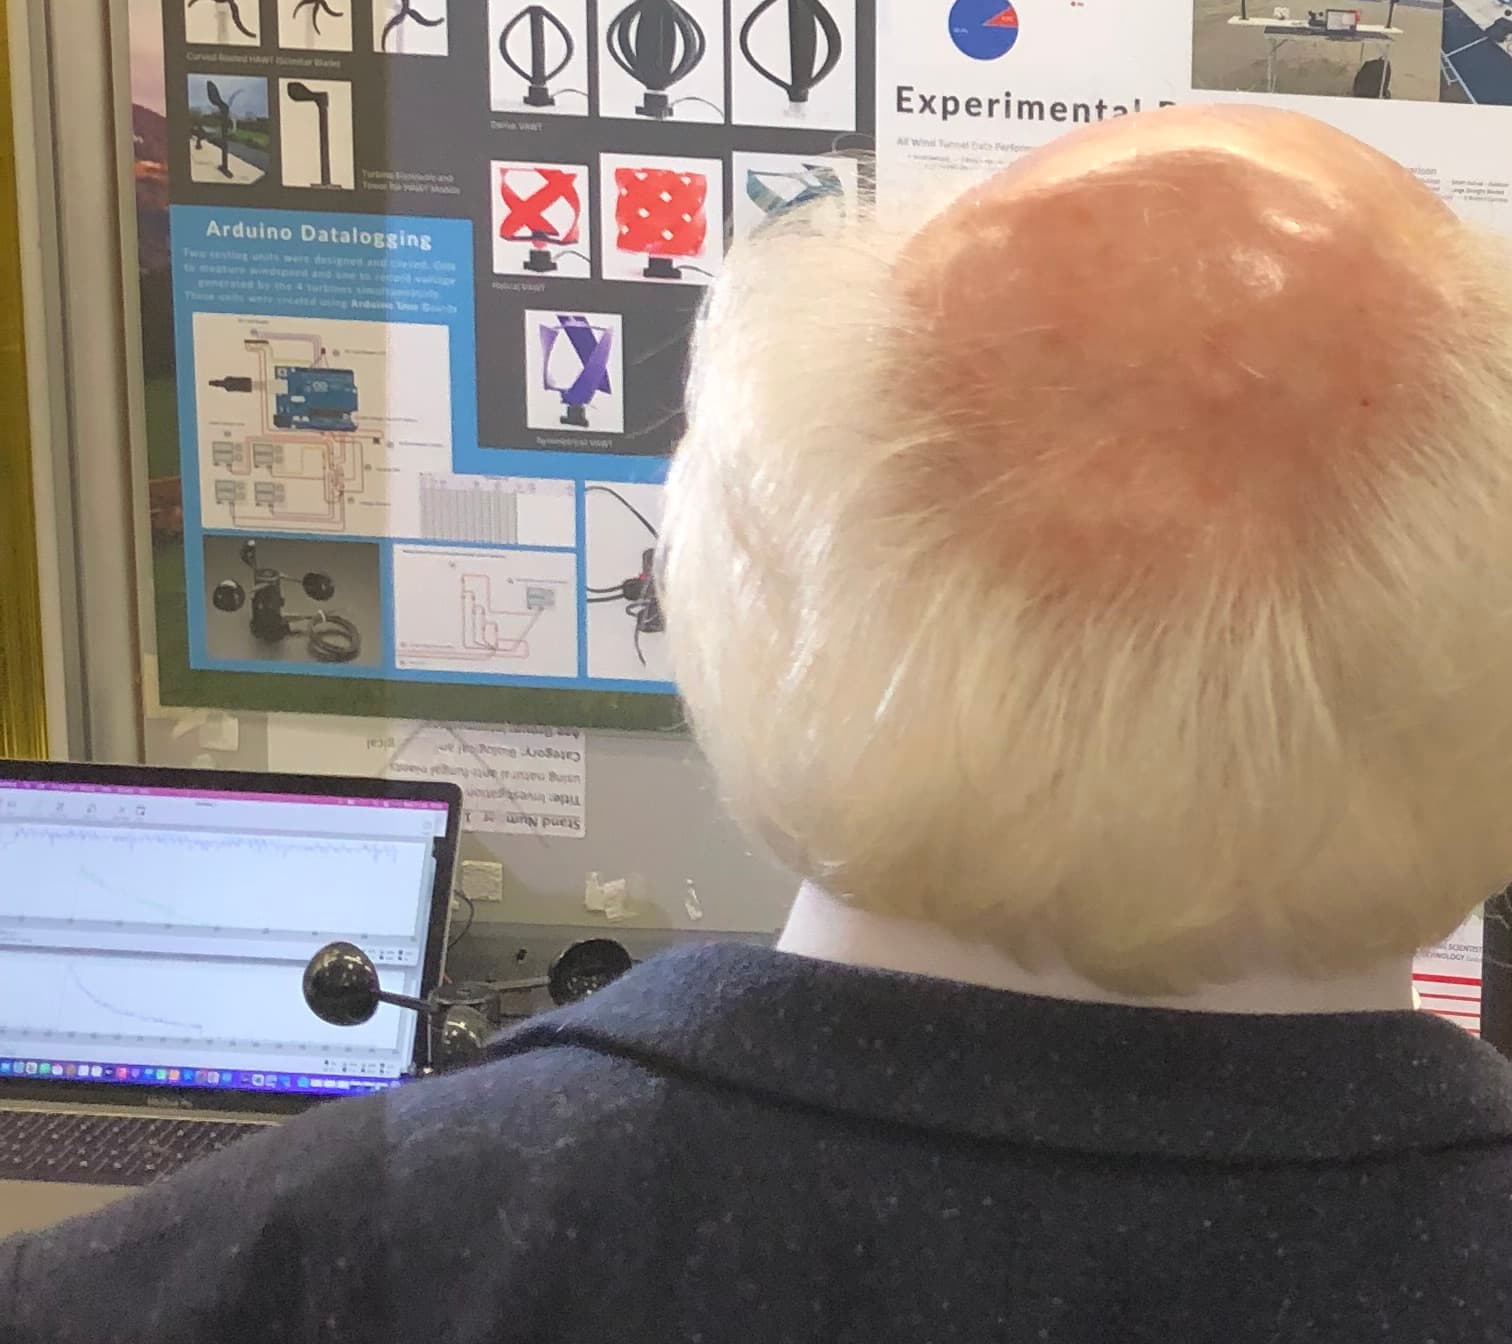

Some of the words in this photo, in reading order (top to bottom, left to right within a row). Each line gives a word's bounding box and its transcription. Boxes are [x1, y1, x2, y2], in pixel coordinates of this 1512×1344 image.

[206, 220, 292, 241] Arduino
[301, 224, 432, 251] Datalogging
[543, 816, 580, 830] Stand
